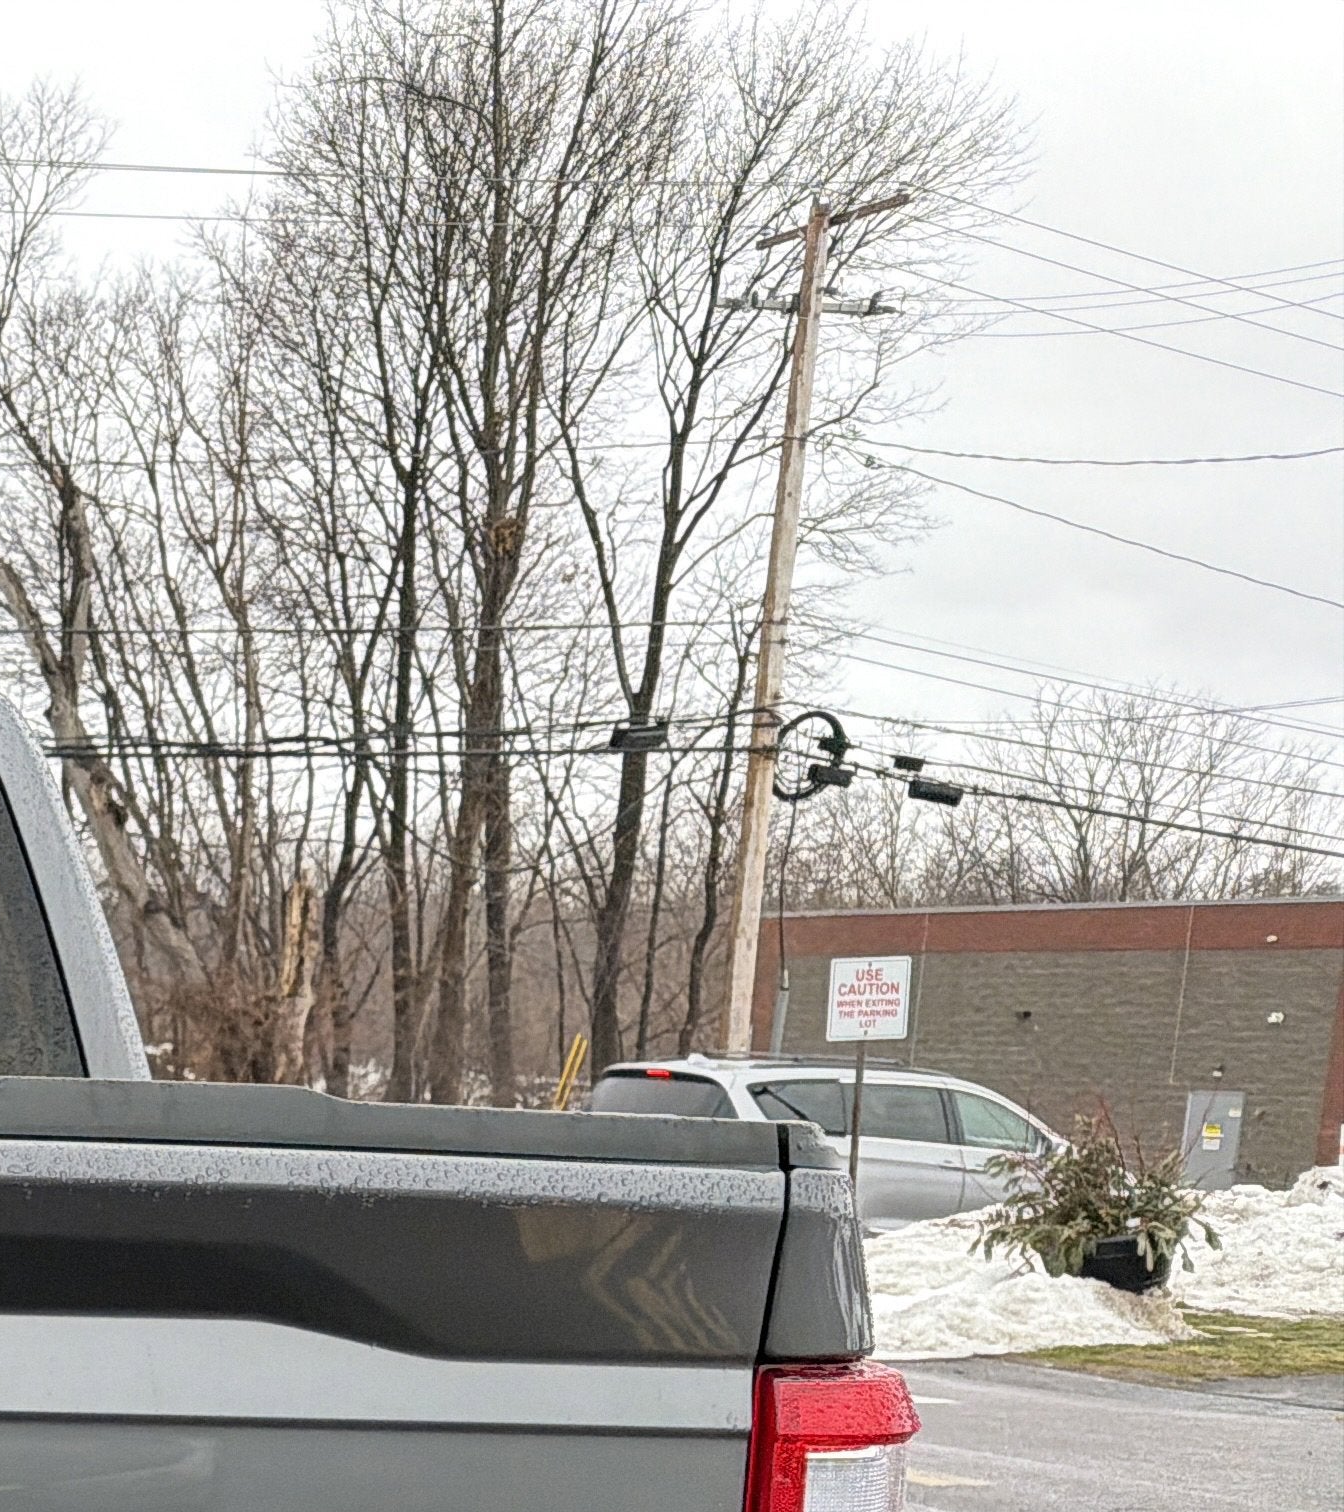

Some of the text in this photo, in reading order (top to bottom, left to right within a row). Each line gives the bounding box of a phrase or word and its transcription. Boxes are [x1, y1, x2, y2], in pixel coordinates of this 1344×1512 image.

[856, 968, 884, 982] USE
[838, 982, 900, 997] CAUTION
[836, 998, 900, 1008] WHEN EXITING
[838, 1008, 898, 1019] THE PARKING
[859, 1019, 876, 1029] LOT
